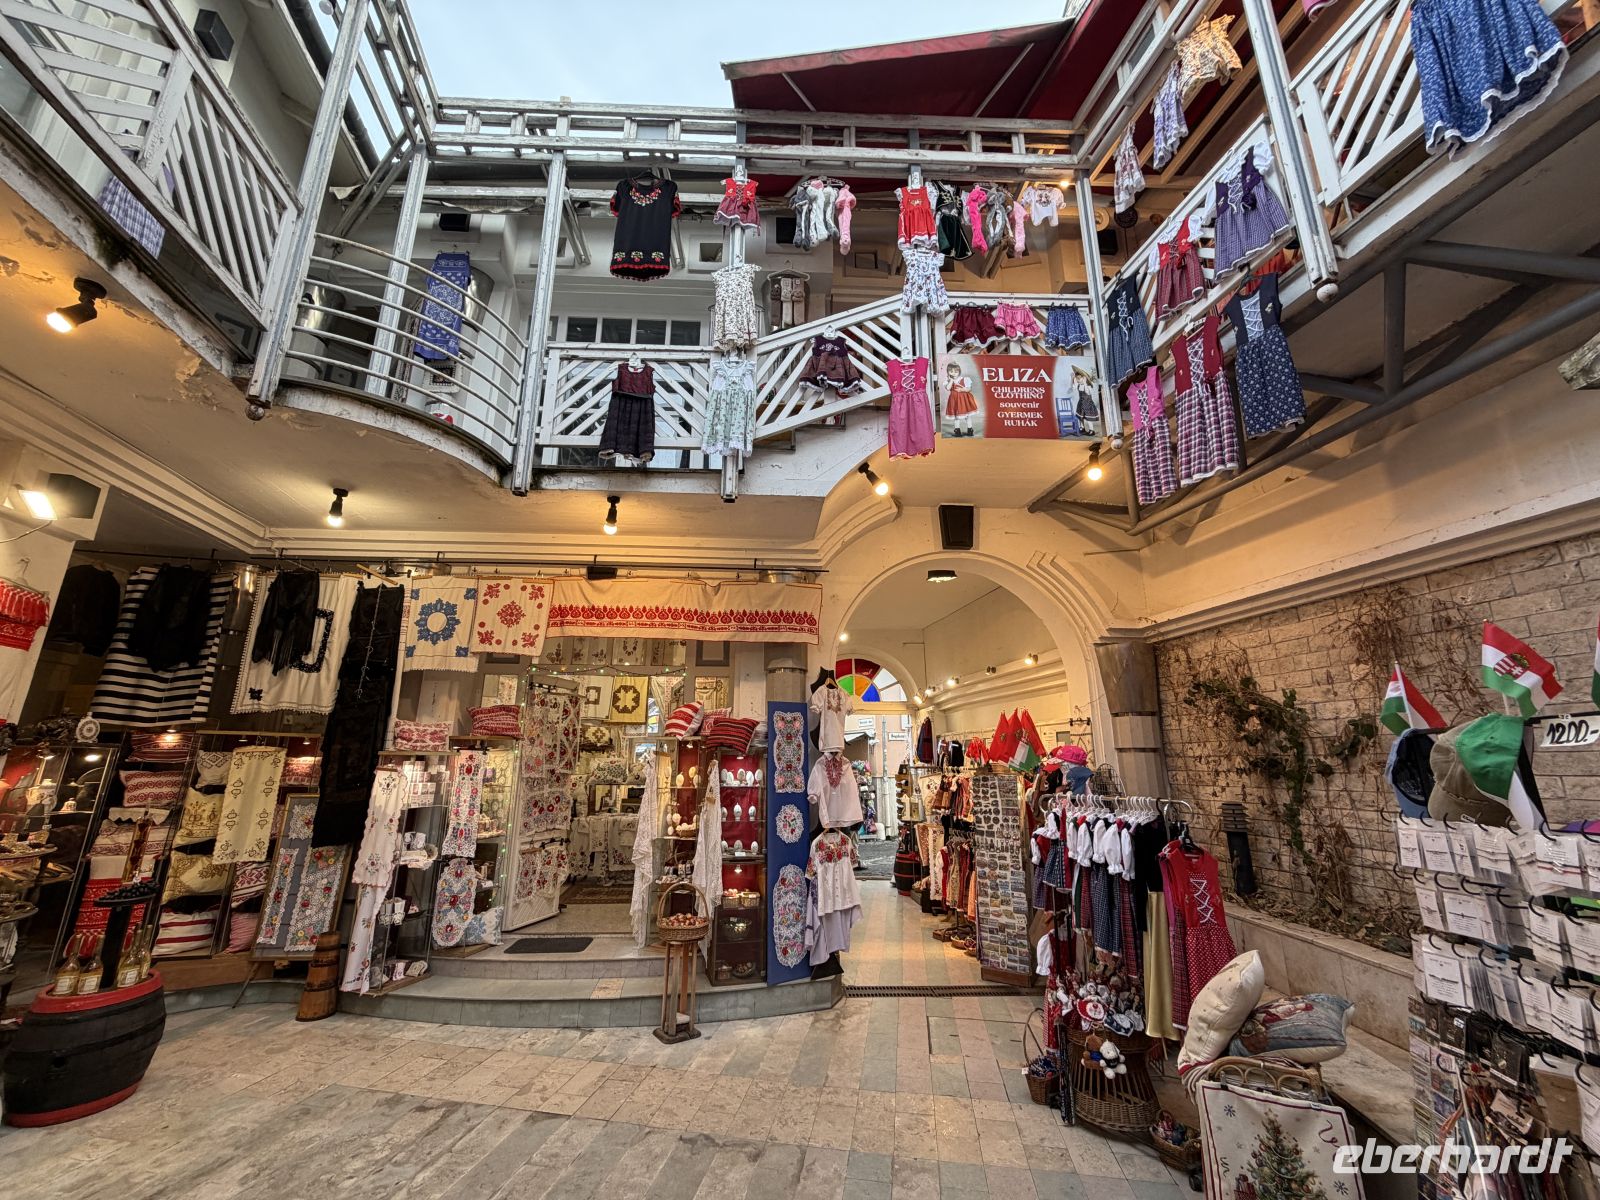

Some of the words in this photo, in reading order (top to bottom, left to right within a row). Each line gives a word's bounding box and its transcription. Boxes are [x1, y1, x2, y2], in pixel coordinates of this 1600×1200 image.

[982, 367, 1053, 383] ELIZA
[991, 386, 1045, 394] CHILDRENS
[994, 392, 1044, 400] CLOTHING
[999, 401, 1040, 409] souvenir
[1004, 418, 1038, 427] RUHÁK
